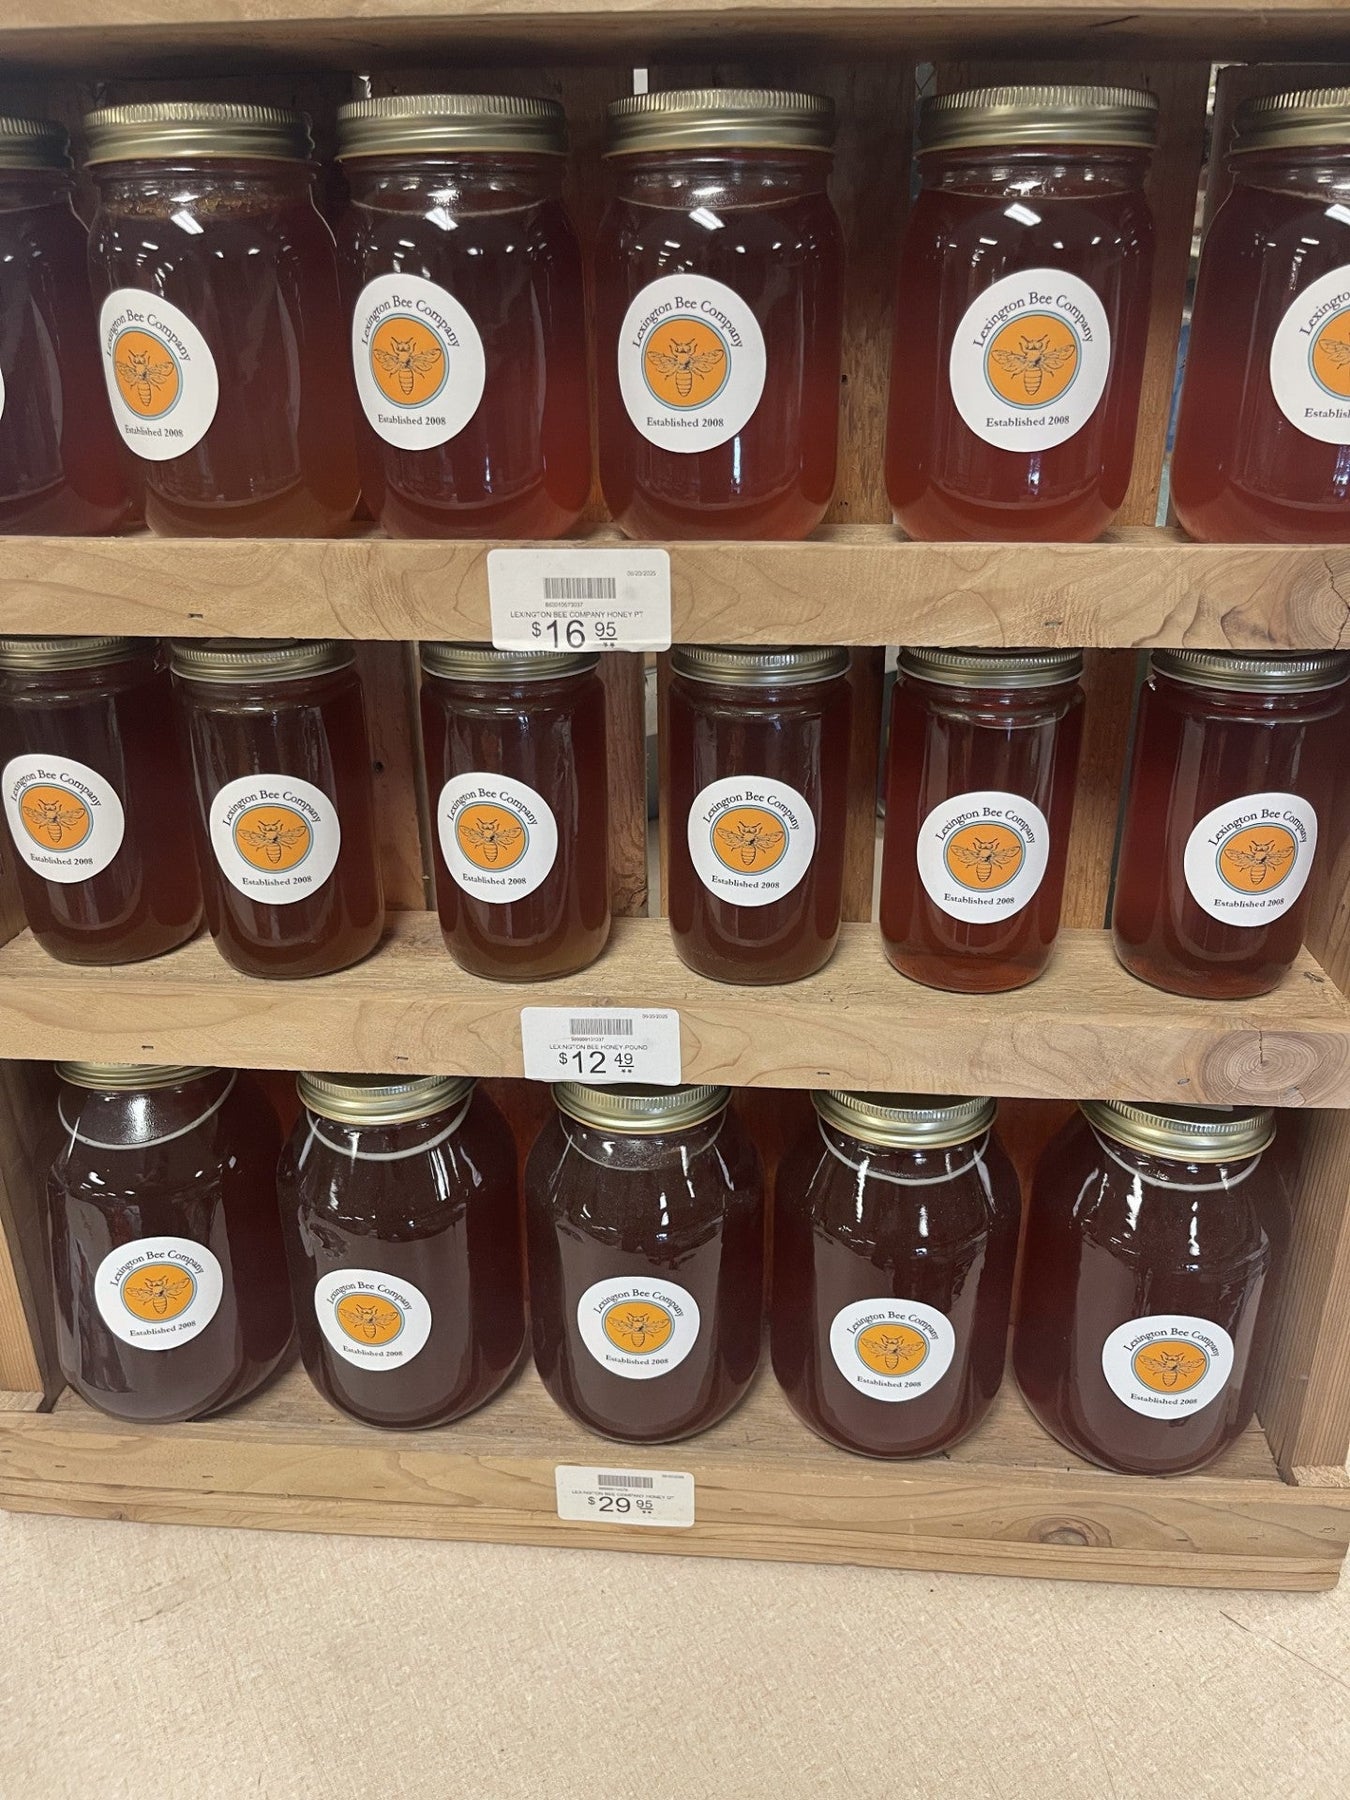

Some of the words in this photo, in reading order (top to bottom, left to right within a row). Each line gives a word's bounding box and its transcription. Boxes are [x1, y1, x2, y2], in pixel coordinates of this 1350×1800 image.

[361, 301, 391, 346] Lexington
[392, 295, 412, 308] Bee
[415, 299, 461, 348] Company
[972, 298, 1026, 348] Lexington
[1028, 291, 1052, 305] Bee
[1056, 294, 1094, 343] Company
[1299, 291, 1350, 337] Lexingto
[632, 302, 673, 348] Lexington
[674, 296, 697, 309] Bee
[700, 300, 743, 348] Company
[126, 309, 145, 323] Bee
[147, 313, 191, 362] Company
[377, 414, 423, 425] Established
[425, 416, 447, 426] 2008
[1304, 407, 1350, 419] Establis
[646, 417, 699, 428] Established
[702, 418, 725, 428] 2008
[985, 417, 1045, 428] Established
[1047, 416, 1070, 426] 2008
[125, 424, 162, 437] Established
[164, 428, 184, 438] 2008
[607, 611, 632, 619] HONEY
[595, 621, 617, 637] 95
[10, 772, 36, 802] Lexington
[37, 770, 57, 779] Bee
[60, 773, 102, 807] Company
[222, 794, 258, 827] Lexington
[259, 790, 280, 799] Bee
[282, 791, 322, 824] Company
[447, 790, 477, 822] Lexington
[478, 788, 497, 798] Bee
[500, 791, 538, 826] Company
[703, 793, 742, 823] Lexington
[745, 791, 765, 802] Bee
[767, 795, 800, 831] Company
[935, 810, 979, 842] Lexington
[982, 807, 1002, 817] Bee
[1005, 809, 1036, 844] Company
[1208, 813, 1258, 846] Lexington
[1261, 809, 1281, 819] Bee
[1283, 810, 1307, 843] Company
[30, 853, 72, 865] Established
[242, 877, 291, 886] Established
[292, 875, 312, 885] 2008
[463, 873, 506, 885] Established
[712, 875, 759, 888] Established
[944, 893, 994, 905] Established
[996, 897, 1015, 905] 2008
[1214, 898, 1266, 908] Established
[1267, 898, 1285, 906] 2008
[614, 1053, 633, 1065] 49
[110, 1255, 145, 1287] Lexington
[146, 1251, 165, 1260] Bee
[167, 1249, 205, 1276] Company
[358, 1281, 374, 1290] Bee
[377, 1284, 413, 1311] Company
[593, 1291, 630, 1314] Lexington
[632, 1289, 650, 1297] Bee
[652, 1291, 684, 1317] Company
[130, 1325, 176, 1337] Established
[178, 1320, 196, 1330] 2008
[847, 1312, 885, 1335] Lexington
[888, 1311, 906, 1320] Bee
[908, 1314, 939, 1340] Company
[1123, 1329, 1167, 1352] Lexington
[1170, 1328, 1189, 1336] Bee
[1191, 1330, 1220, 1357] Company
[343, 1345, 384, 1357] Established
[606, 1354, 649, 1365] Established
[857, 1376, 902, 1388] Established
[1130, 1393, 1178, 1405] Established
[636, 1500, 653, 1508] 95
